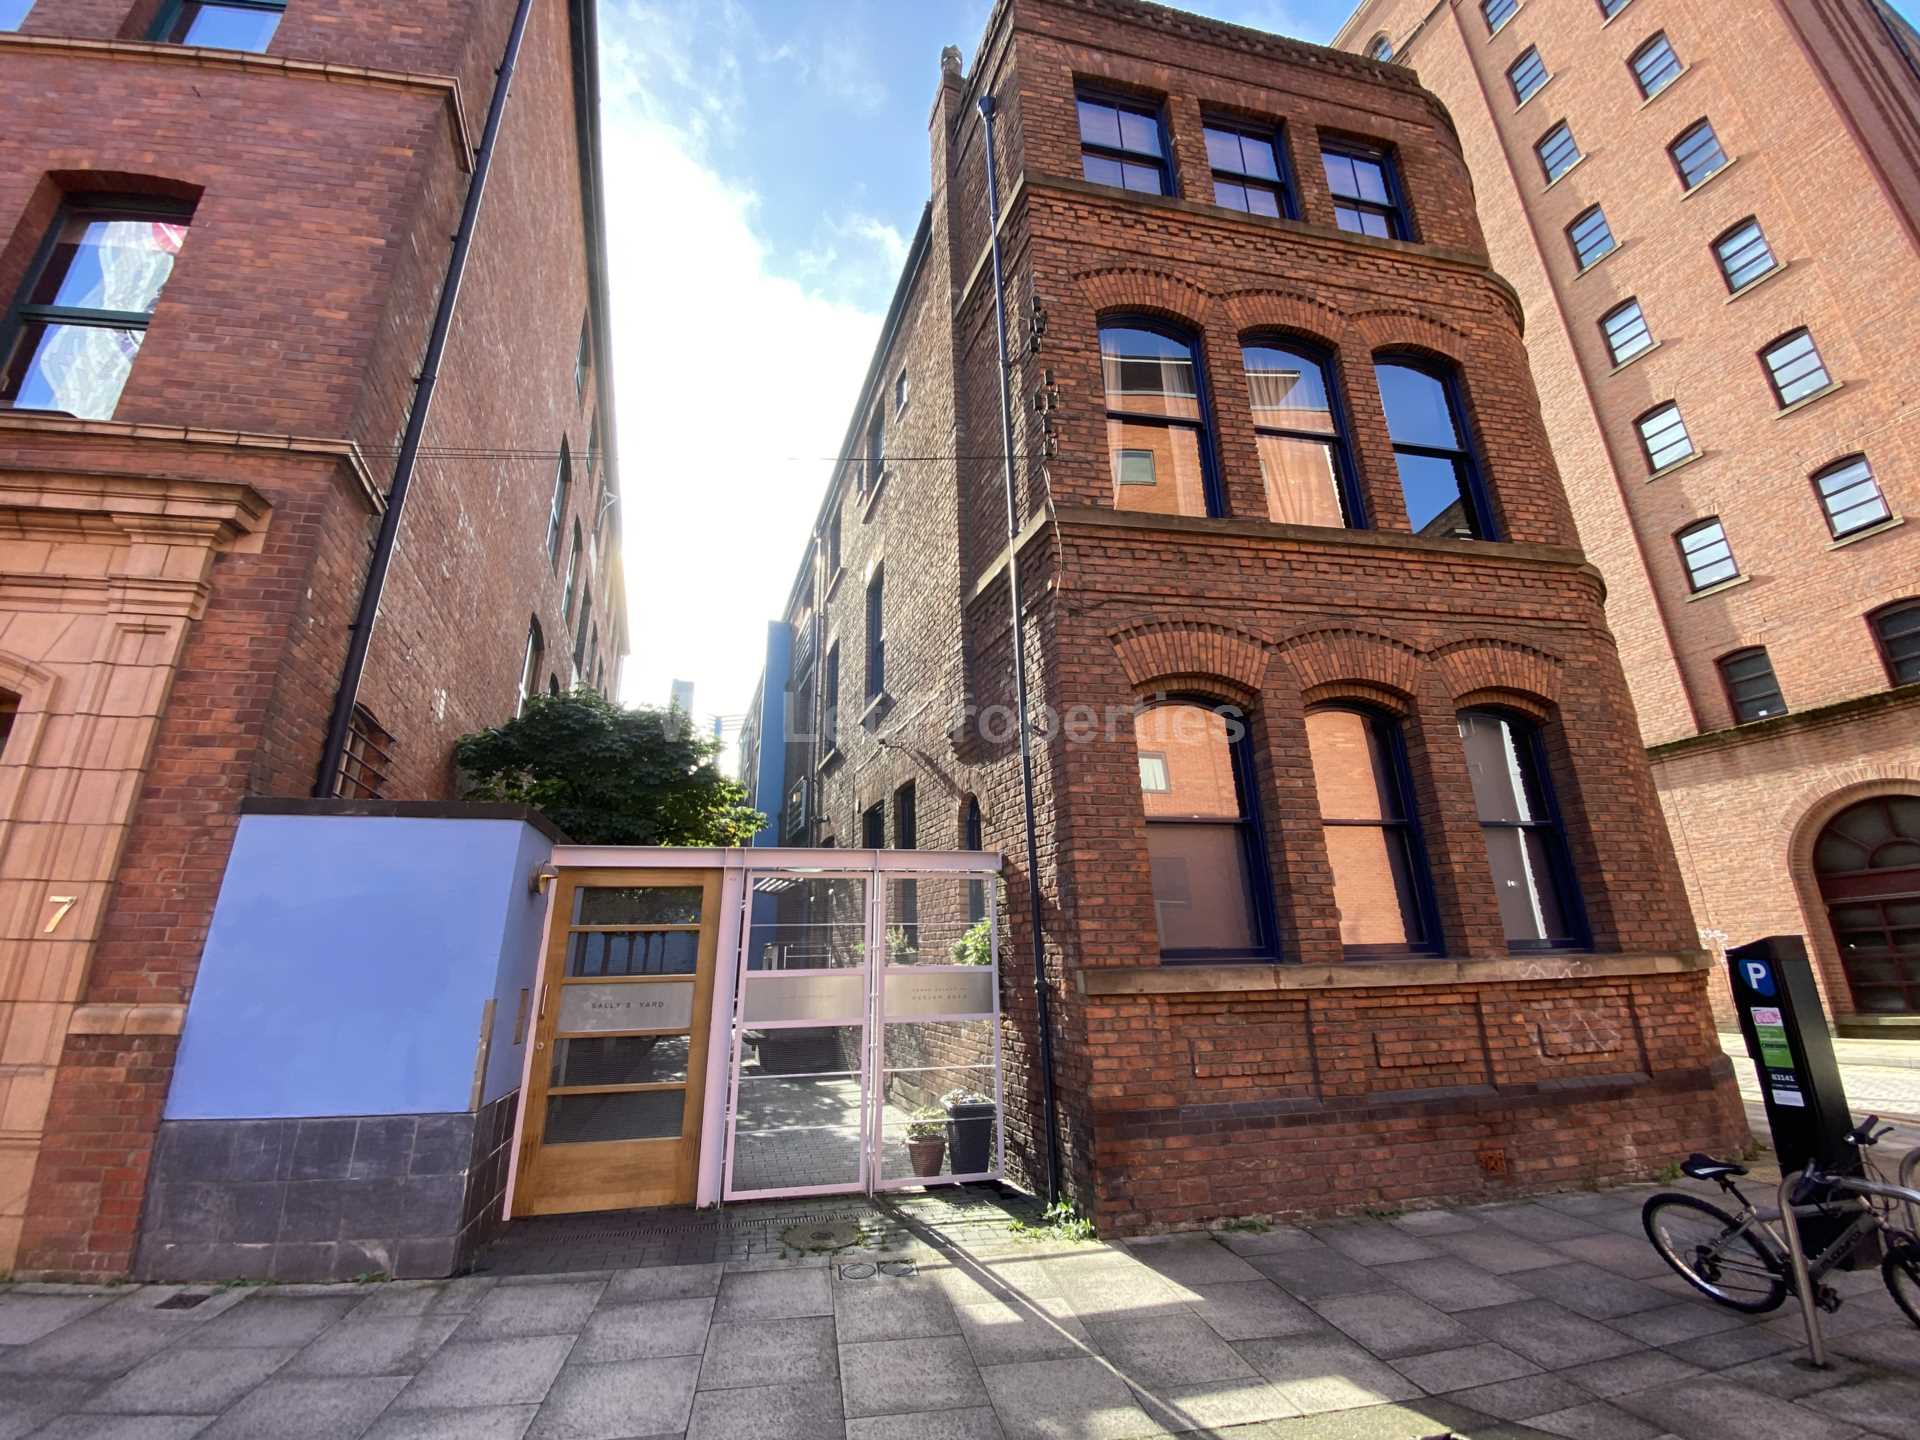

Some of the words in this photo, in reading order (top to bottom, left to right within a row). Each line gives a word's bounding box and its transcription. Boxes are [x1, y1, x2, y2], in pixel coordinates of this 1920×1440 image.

[43, 895, 78, 933] 7
[1746, 962, 1767, 989] P
[639, 1000, 665, 1009] YARD
